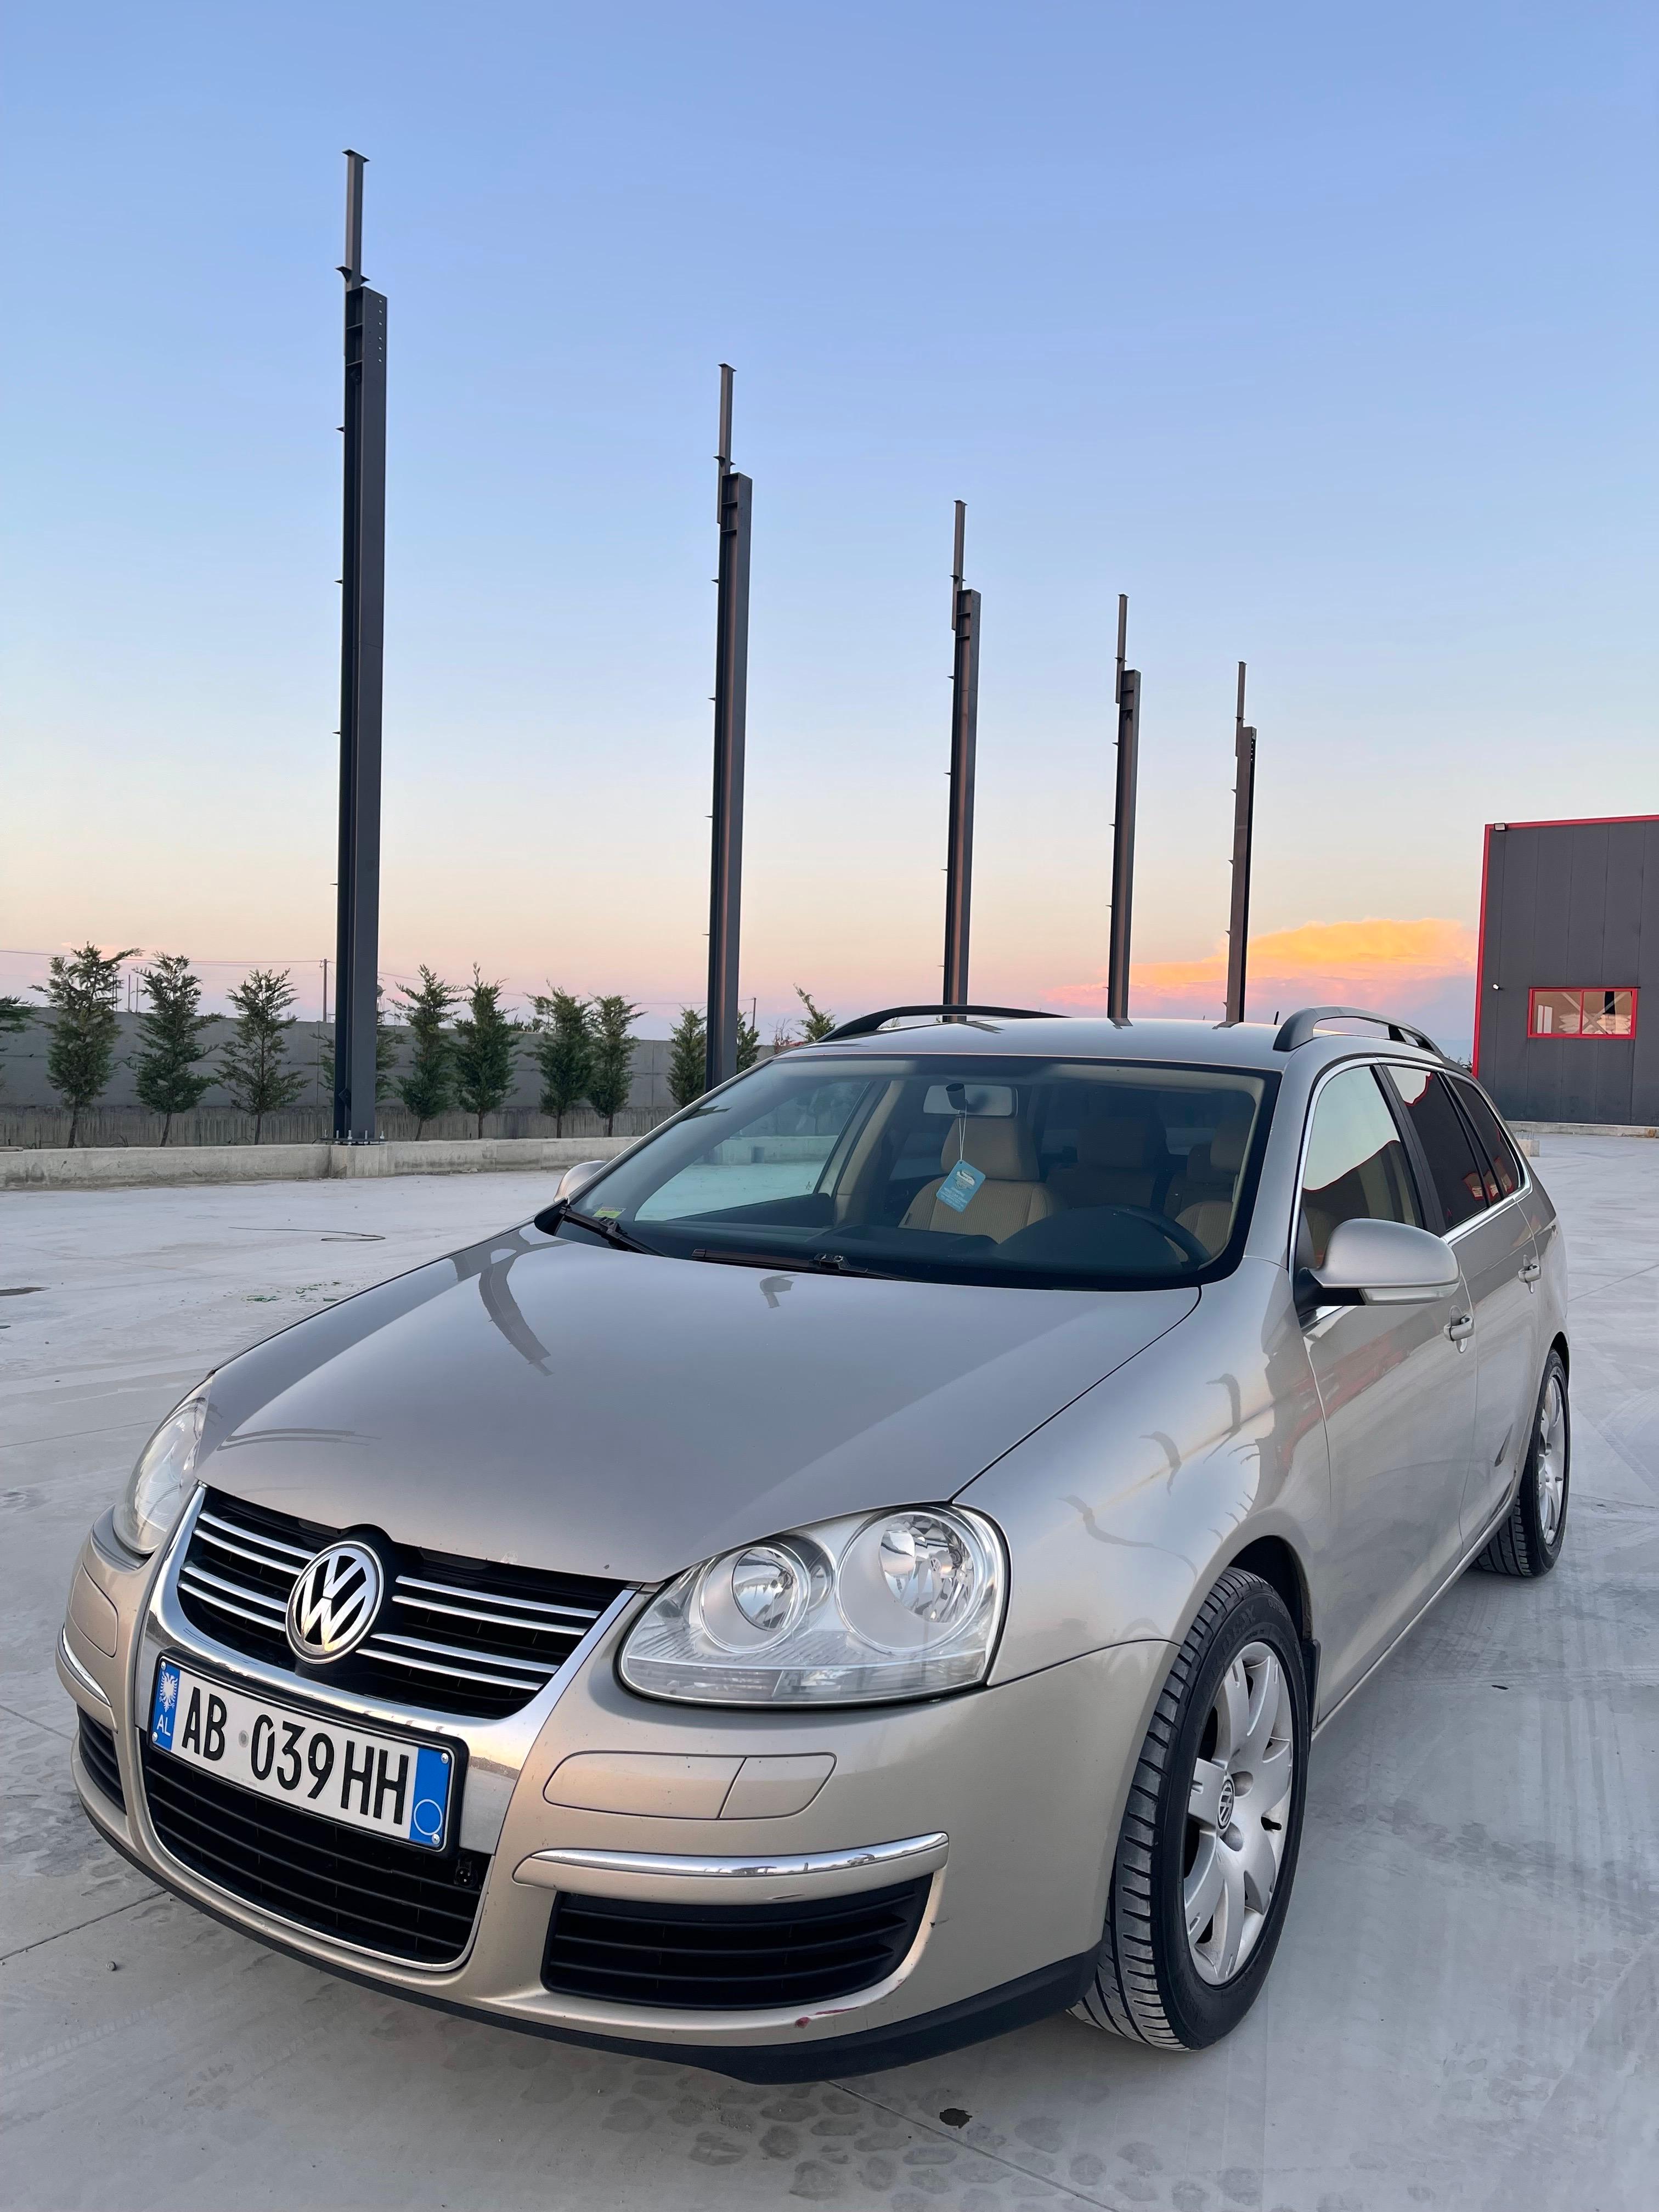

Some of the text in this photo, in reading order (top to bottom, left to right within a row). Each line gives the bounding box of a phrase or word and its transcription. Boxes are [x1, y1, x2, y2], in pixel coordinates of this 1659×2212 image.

[293, 1548, 376, 1654] VW
[156, 1714, 171, 1736] AL
[182, 1686, 409, 1824] AB 039 HH
